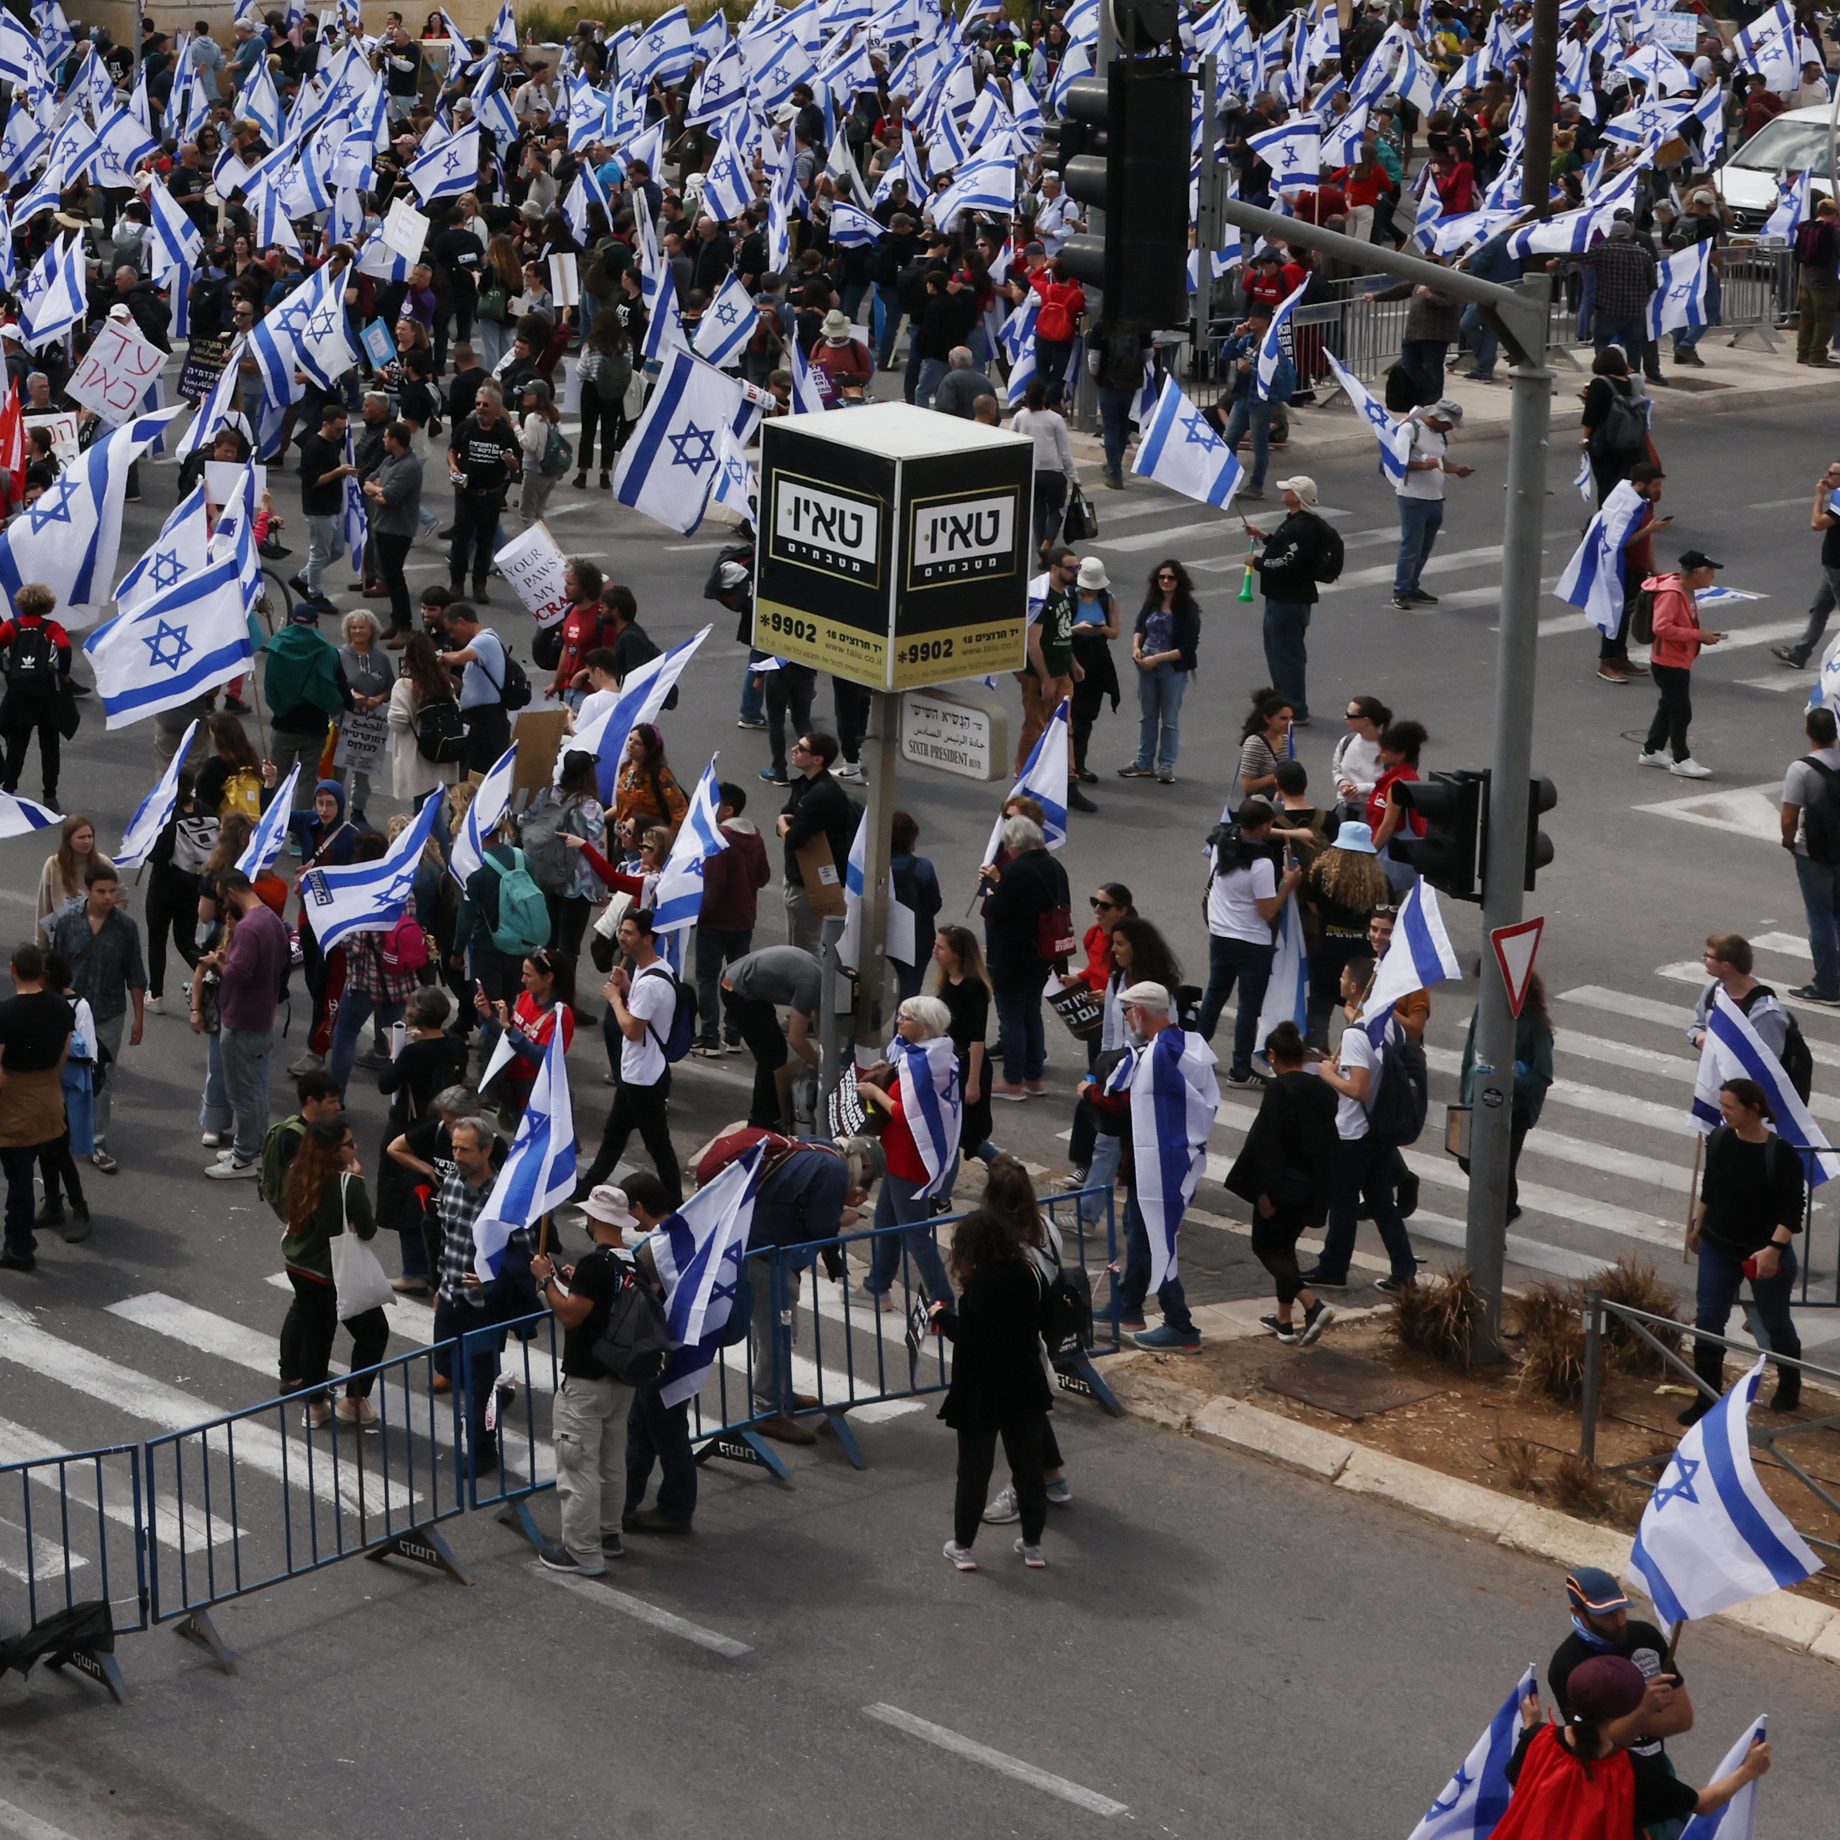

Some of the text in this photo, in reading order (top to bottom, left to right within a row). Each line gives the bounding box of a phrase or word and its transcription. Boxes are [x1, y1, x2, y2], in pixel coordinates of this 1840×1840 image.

[108, 328, 162, 375] עד
[75, 355, 137, 411] כאן!
[504, 548, 543, 578] YOUR
[788, 543, 861, 572] מטבחים
[925, 557, 997, 577] מטבחים
[523, 558, 558, 588] PAWS
[533, 582, 556, 603] MY
[910, 703, 939, 722] השישי
[942, 711, 971, 731] הנשיא
[909, 740, 930, 757] SIXTH
[931, 743, 968, 767] PRESIDENT
[1071, 990, 1089, 1006] אין
[1078, 1004, 1100, 1022] עם
